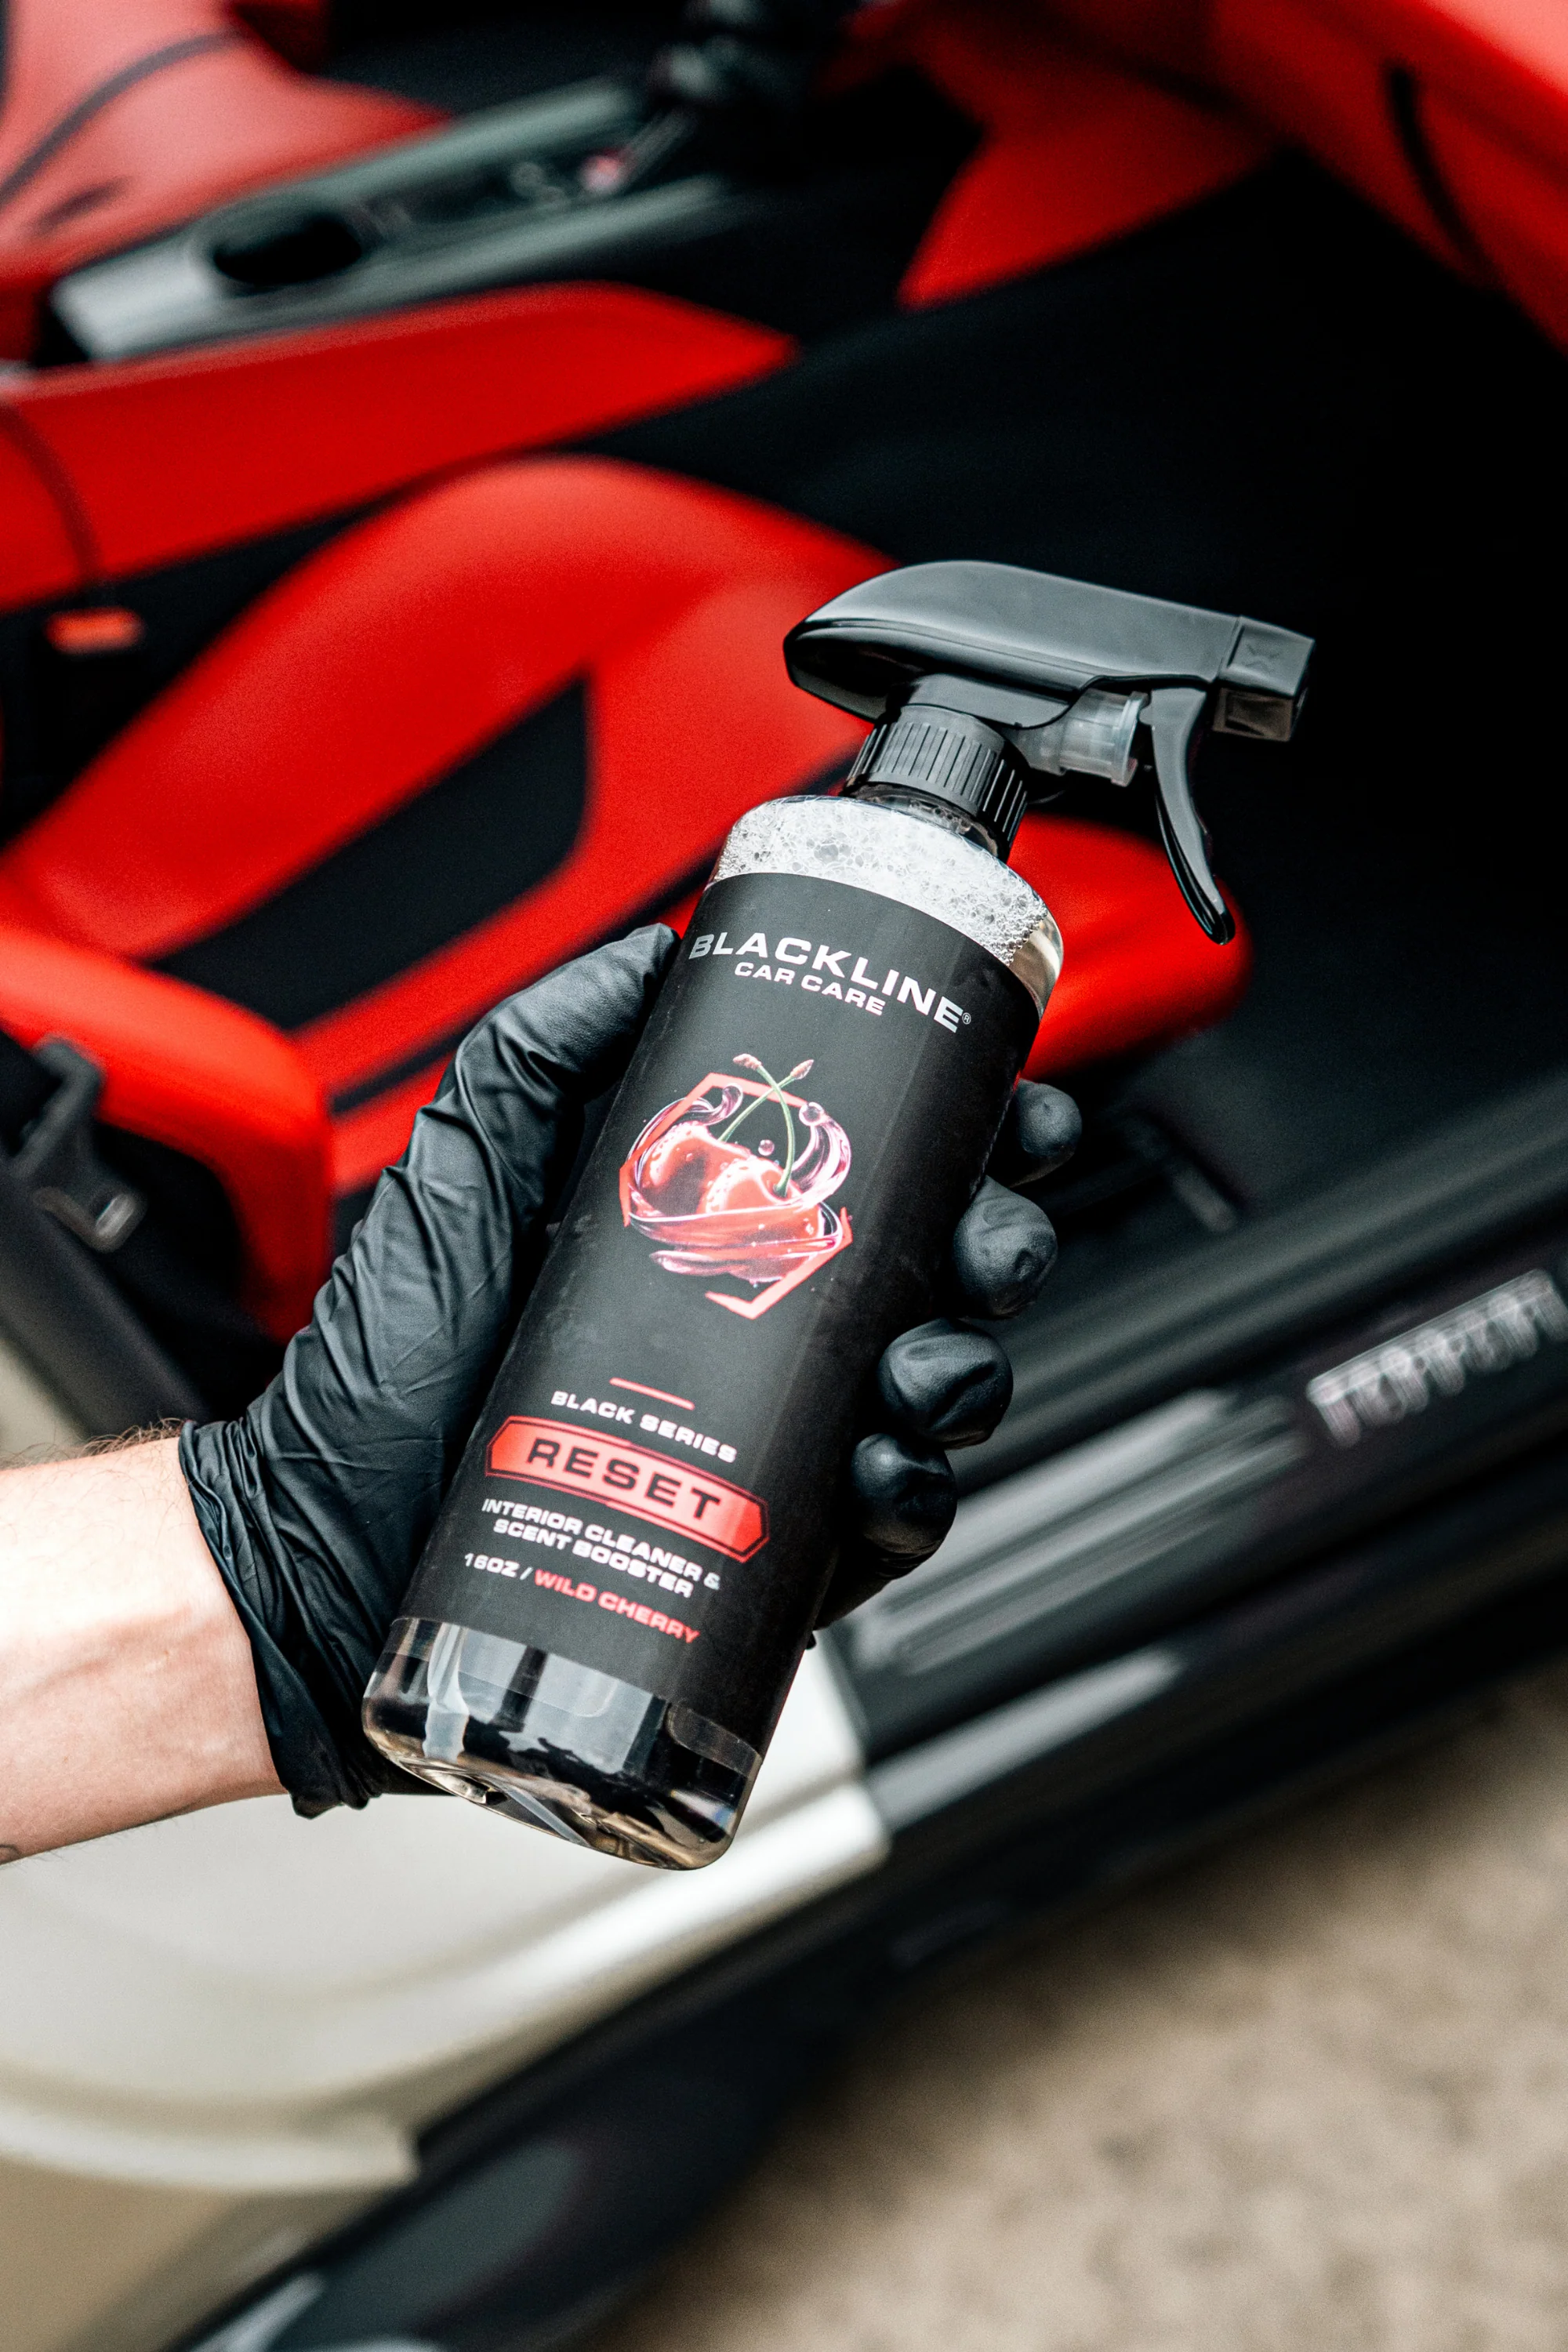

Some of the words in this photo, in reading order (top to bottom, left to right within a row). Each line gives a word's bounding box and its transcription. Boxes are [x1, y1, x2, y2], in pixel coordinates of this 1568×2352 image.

[735, 962, 796, 985] CAR
[801, 975, 886, 1016] CARE
[550, 1390, 635, 1425] BLACK
[640, 1414, 738, 1464] SERIES
[526, 1437, 722, 1521] RESET
[482, 1498, 583, 1535] INTERIOR
[585, 1523, 702, 1581] CLEANER
[703, 1571, 720, 1591] &
[493, 1519, 572, 1550] SCENT
[572, 1540, 695, 1599] BOOSTER
[464, 1553, 521, 1577] 16OZ
[535, 1568, 598, 1603] WILD
[598, 1591, 701, 1644] CHERRY
